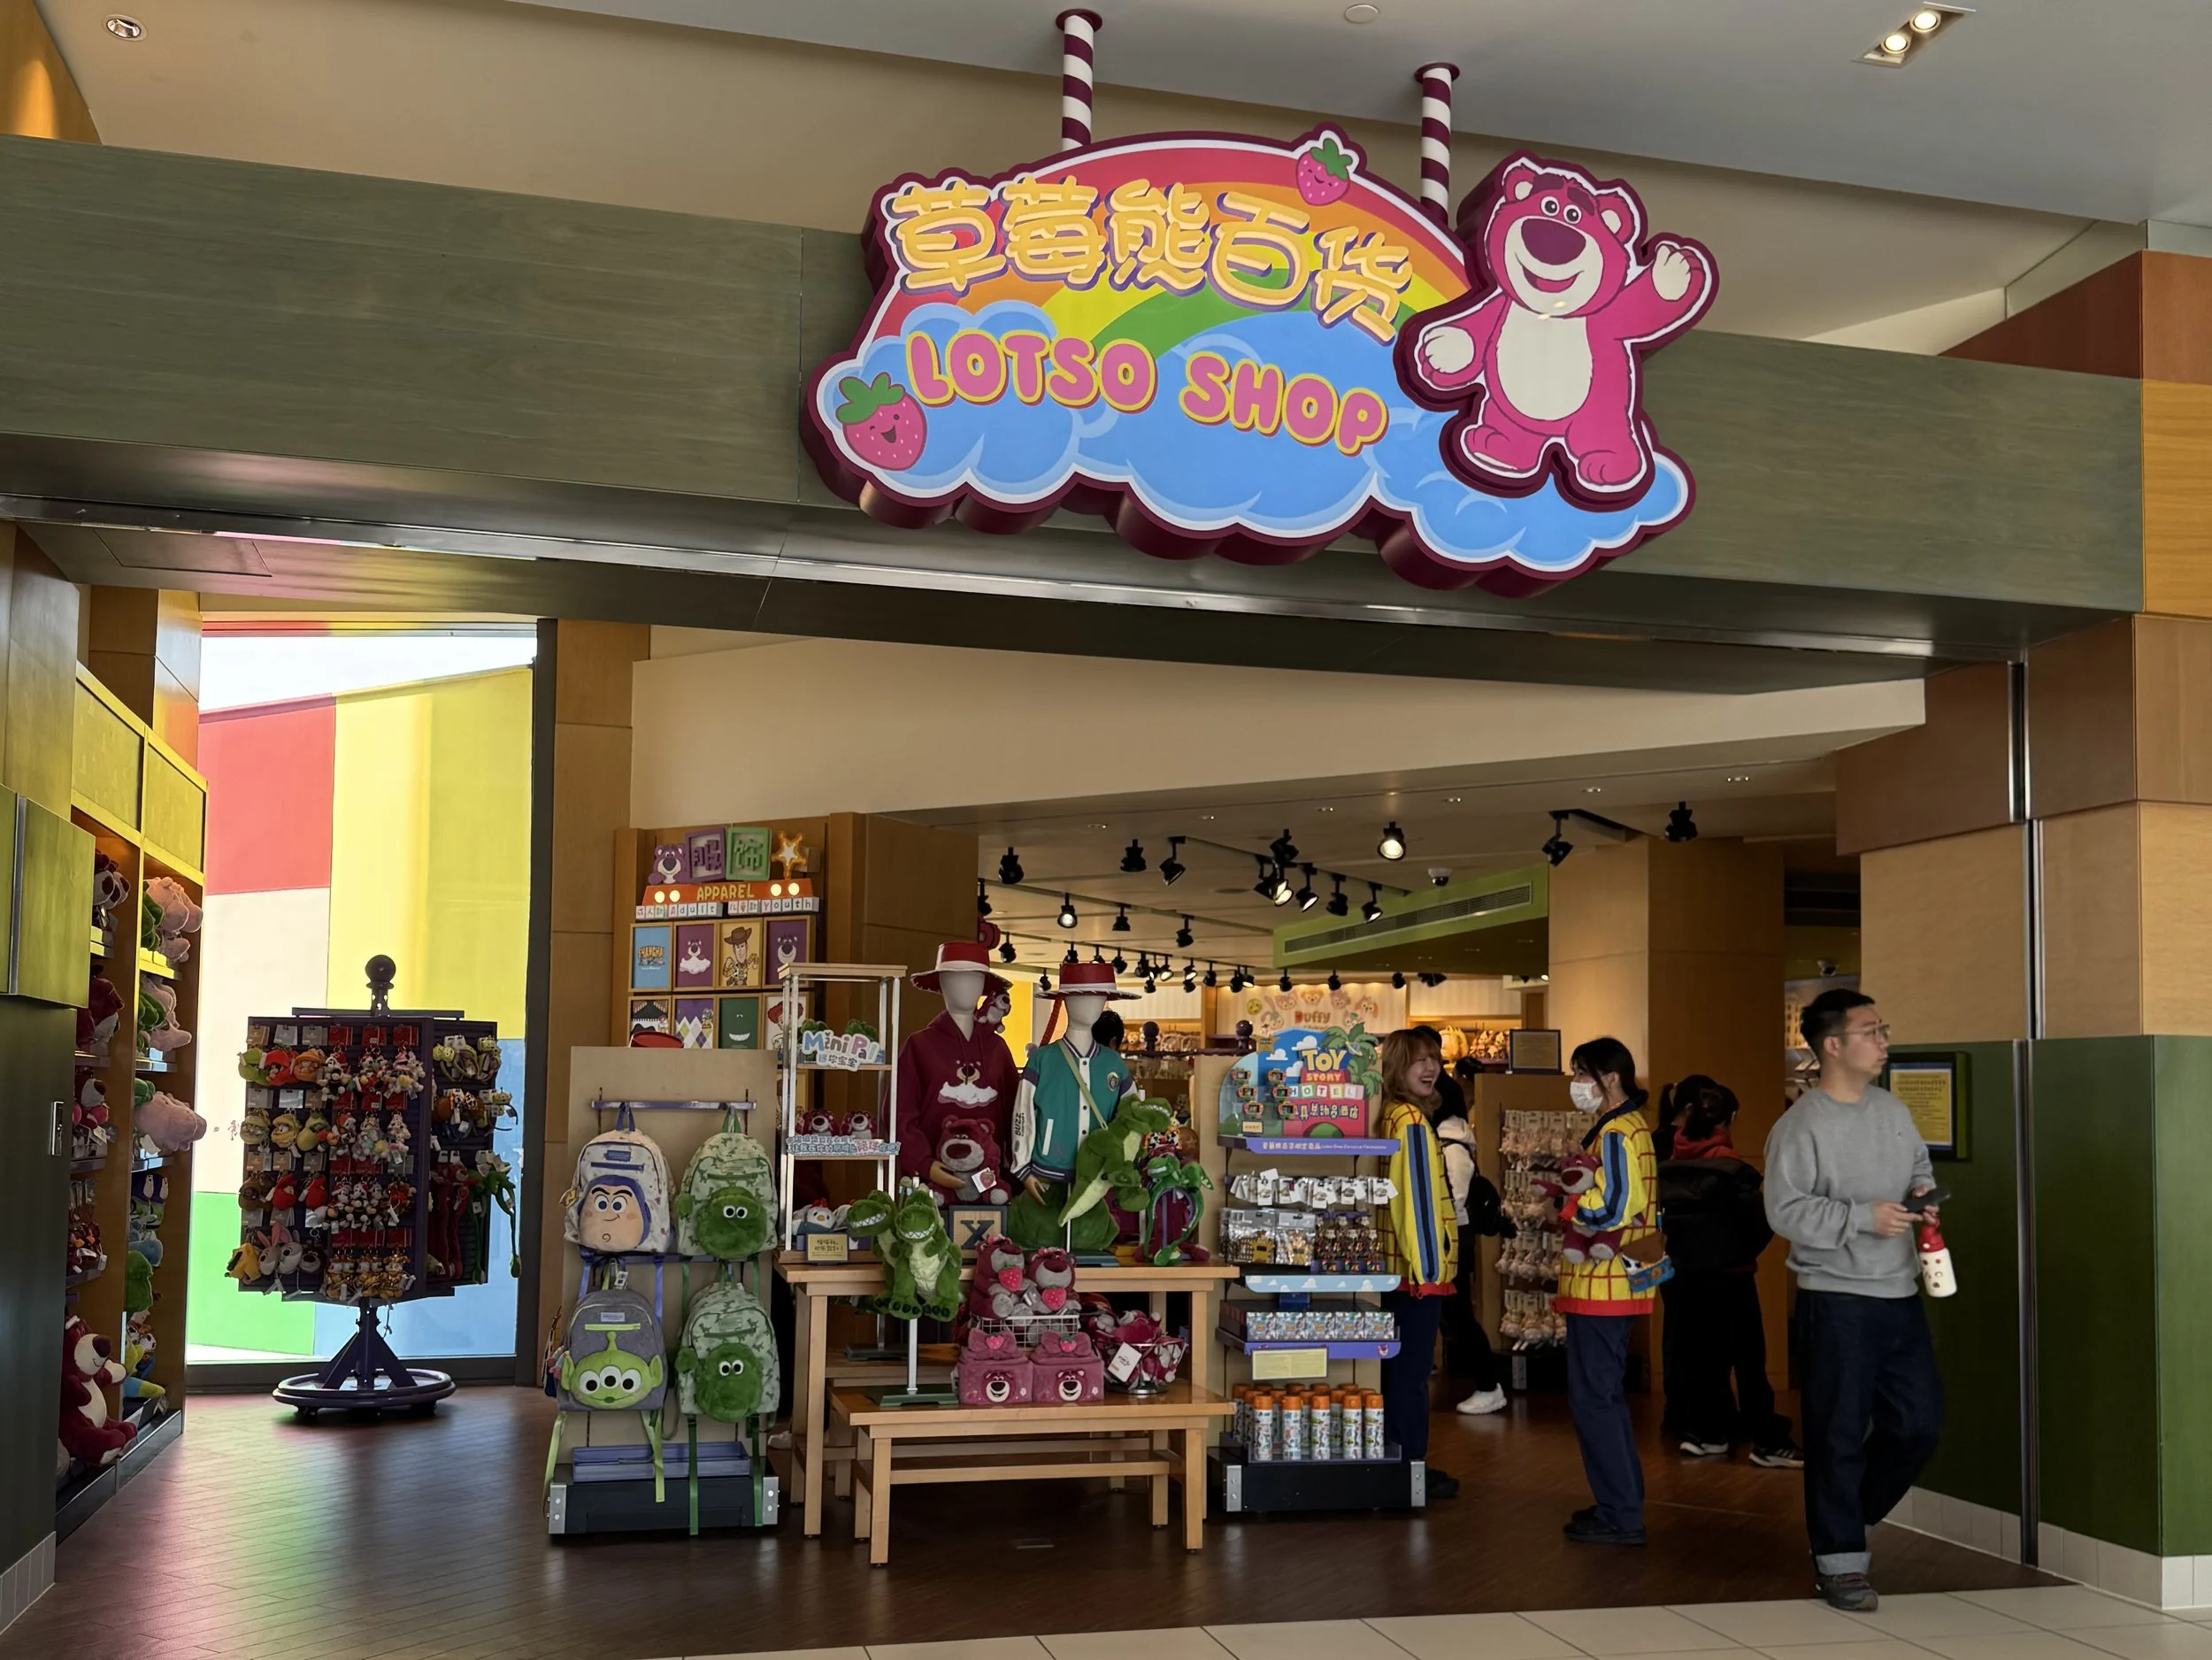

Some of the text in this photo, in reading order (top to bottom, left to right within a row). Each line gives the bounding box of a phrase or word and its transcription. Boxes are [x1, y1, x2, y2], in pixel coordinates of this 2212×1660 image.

[888, 175, 1415, 344] 草莓熊百货
[905, 332, 1391, 457] LOTSO SHOP
[697, 884, 755, 901] APPAREL
[670, 903, 714, 915] Adult
[1302, 1049, 1347, 1072] TOY
[1306, 1072, 1342, 1081] STORY
[1291, 1085, 1355, 1096] HOTEL
[1294, 1103, 1359, 1120] 具总动员酒店
[960, 1219, 995, 1249] X
